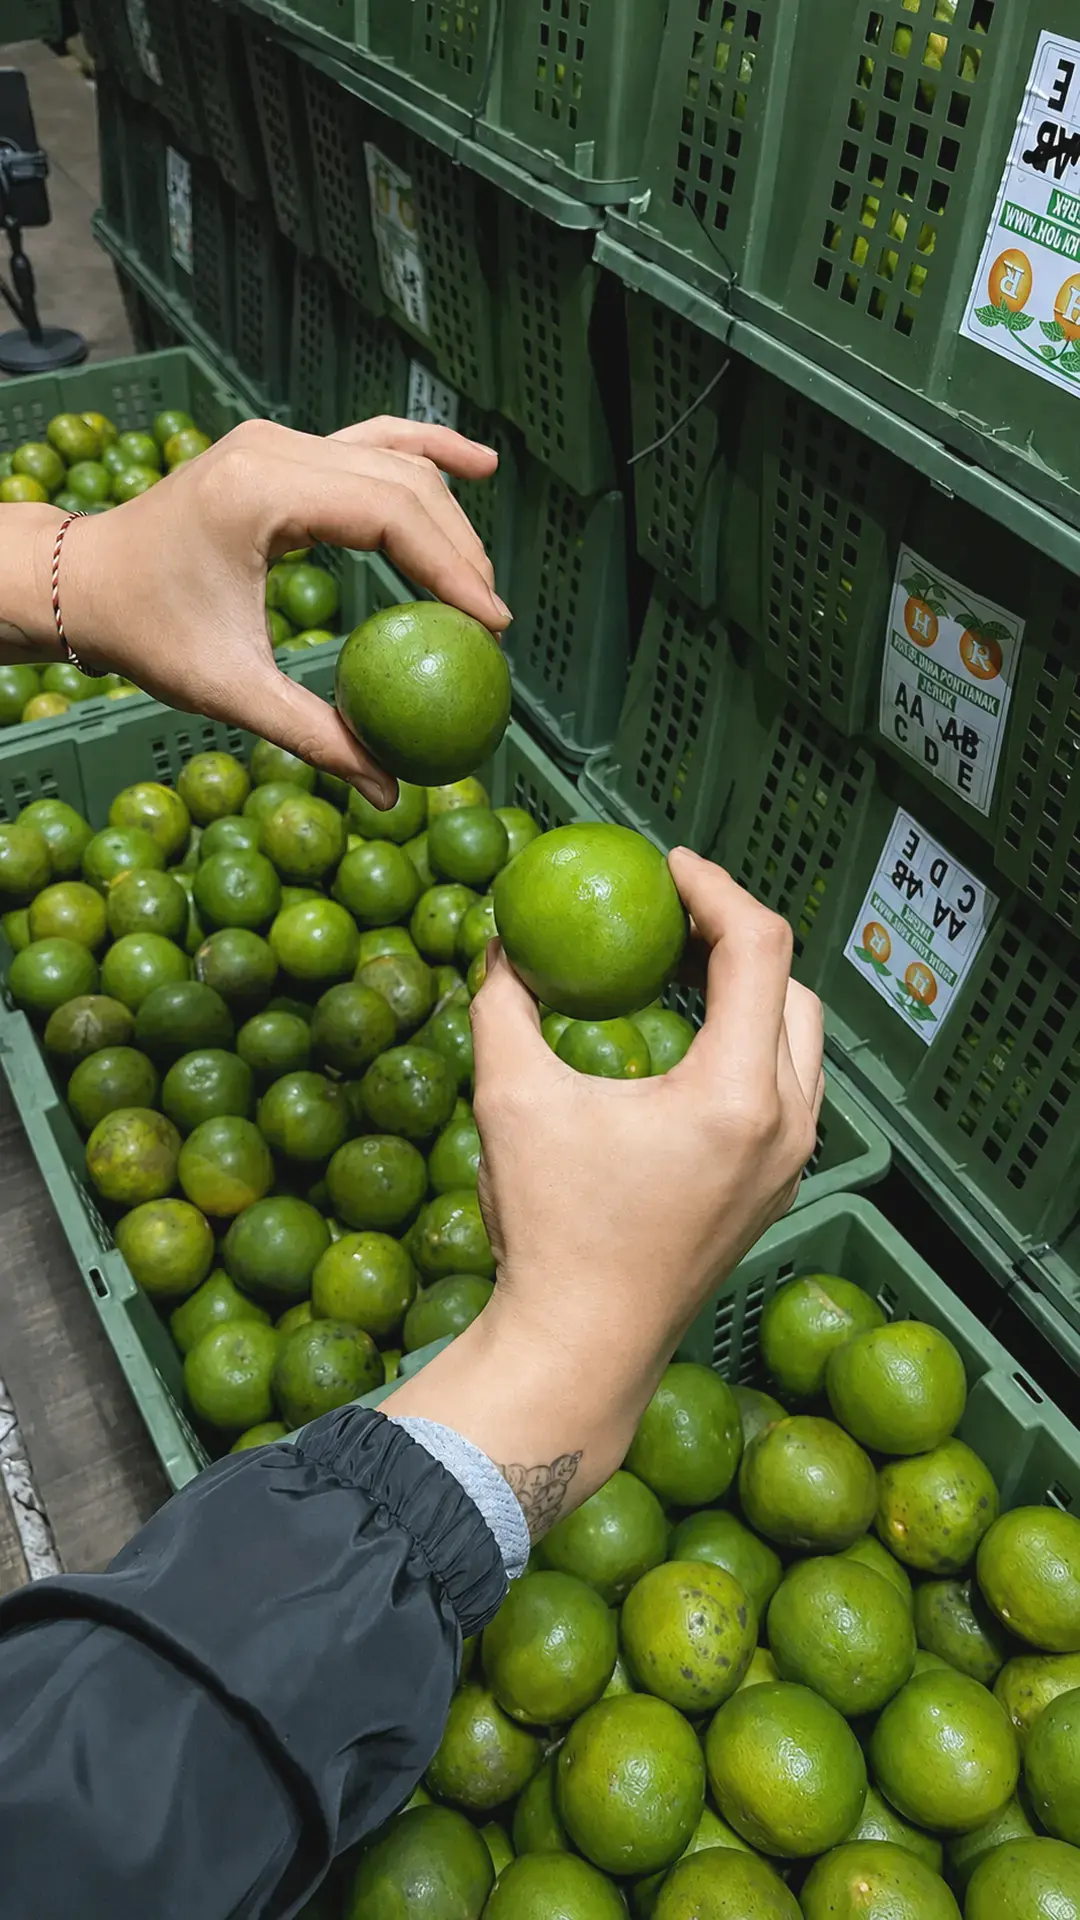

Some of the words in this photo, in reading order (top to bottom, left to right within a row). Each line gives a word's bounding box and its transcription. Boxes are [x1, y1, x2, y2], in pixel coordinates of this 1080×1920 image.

[1047, 58, 1075, 112] E
[1000, 260, 1025, 300] R
[912, 607, 931, 639] H
[969, 640, 991, 672] R
[895, 682, 924, 727] AA
[895, 714, 908, 743] C
[925, 735, 939, 767] D
[958, 759, 974, 794] E
[902, 829, 920, 861] E
[930, 858, 948, 889] D
[933, 896, 967, 941] AA
[958, 884, 976, 914] C
